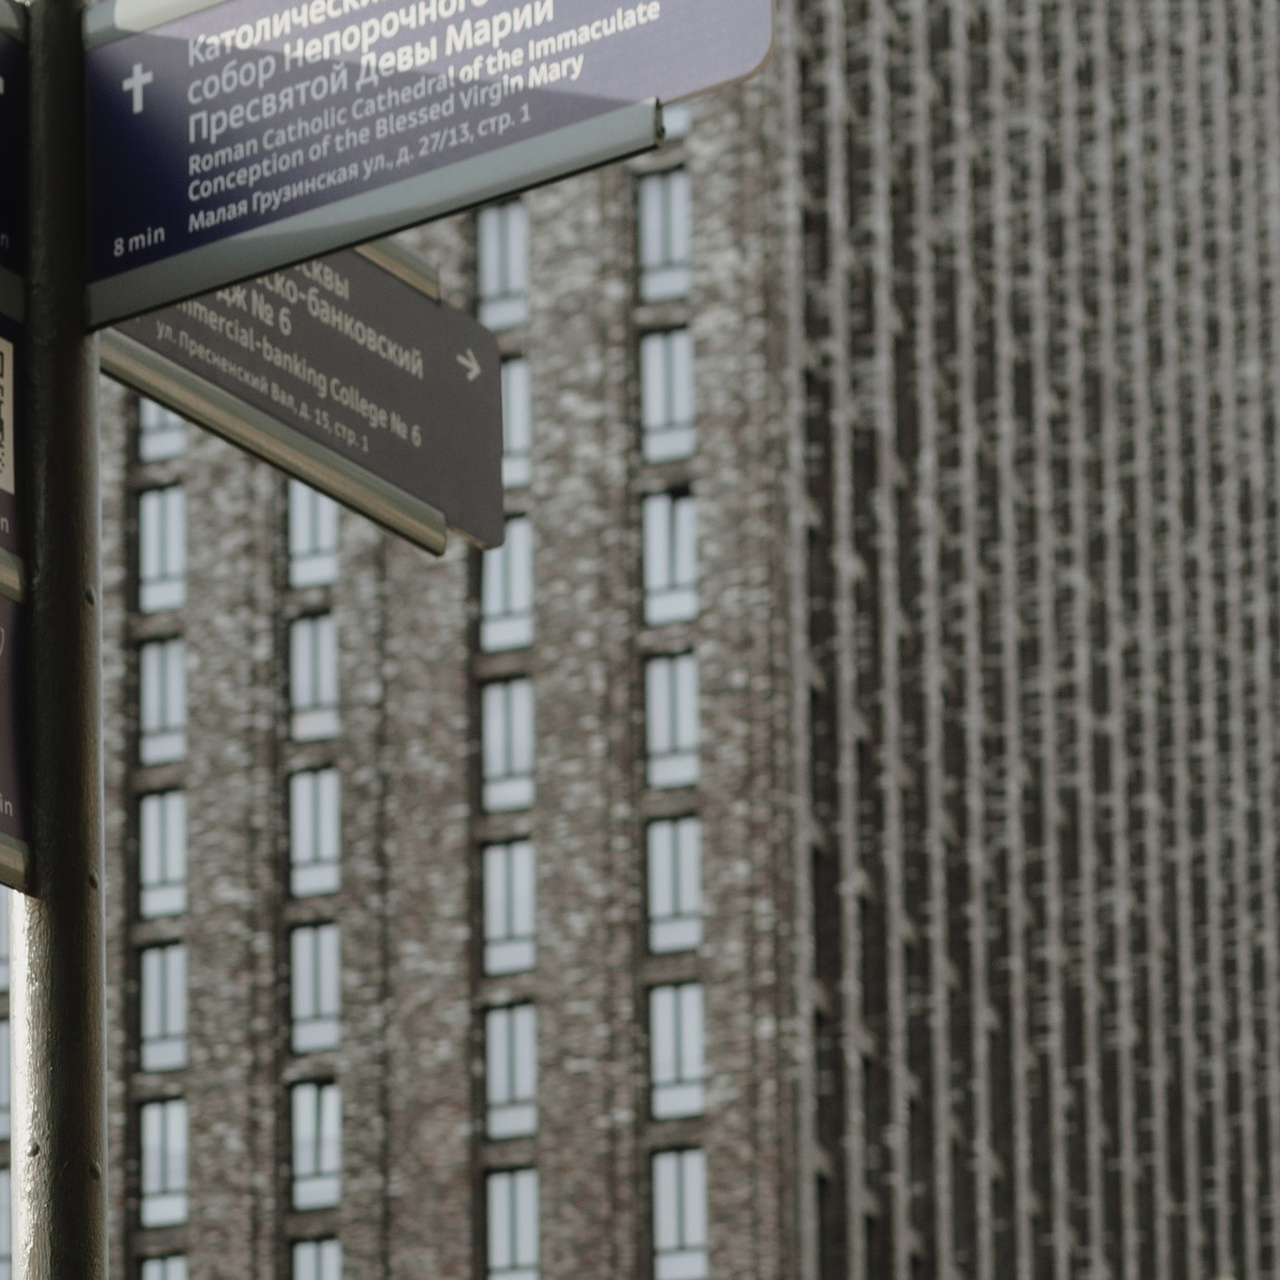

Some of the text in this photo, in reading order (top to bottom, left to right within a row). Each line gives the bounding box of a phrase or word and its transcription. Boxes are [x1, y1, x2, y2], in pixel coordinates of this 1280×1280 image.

[186, 54, 277, 105] собор
[187, 1, 661, 177] Roman Catholic Cathedral of the Immaculate
[187, 61, 349, 145] Пресвятой
[354, 34, 438, 93] Девы
[187, 52, 585, 202] Conception of the Blessed Virgin Mary
[187, 198, 248, 234] Малая
[251, 163, 359, 215] Грузинская
[395, 145, 414, 168] д.
[417, 121, 475, 157] 27/13,
[476, 112, 516, 137] стр.
[519, 102, 531, 123] 1
[112, 225, 166, 258] 8 min
[278, 305, 292, 337] 6
[155, 319, 177, 344] ул.
[361, 434, 369, 453] 1
[329, 376, 388, 429] College
[410, 423, 422, 448] 6
